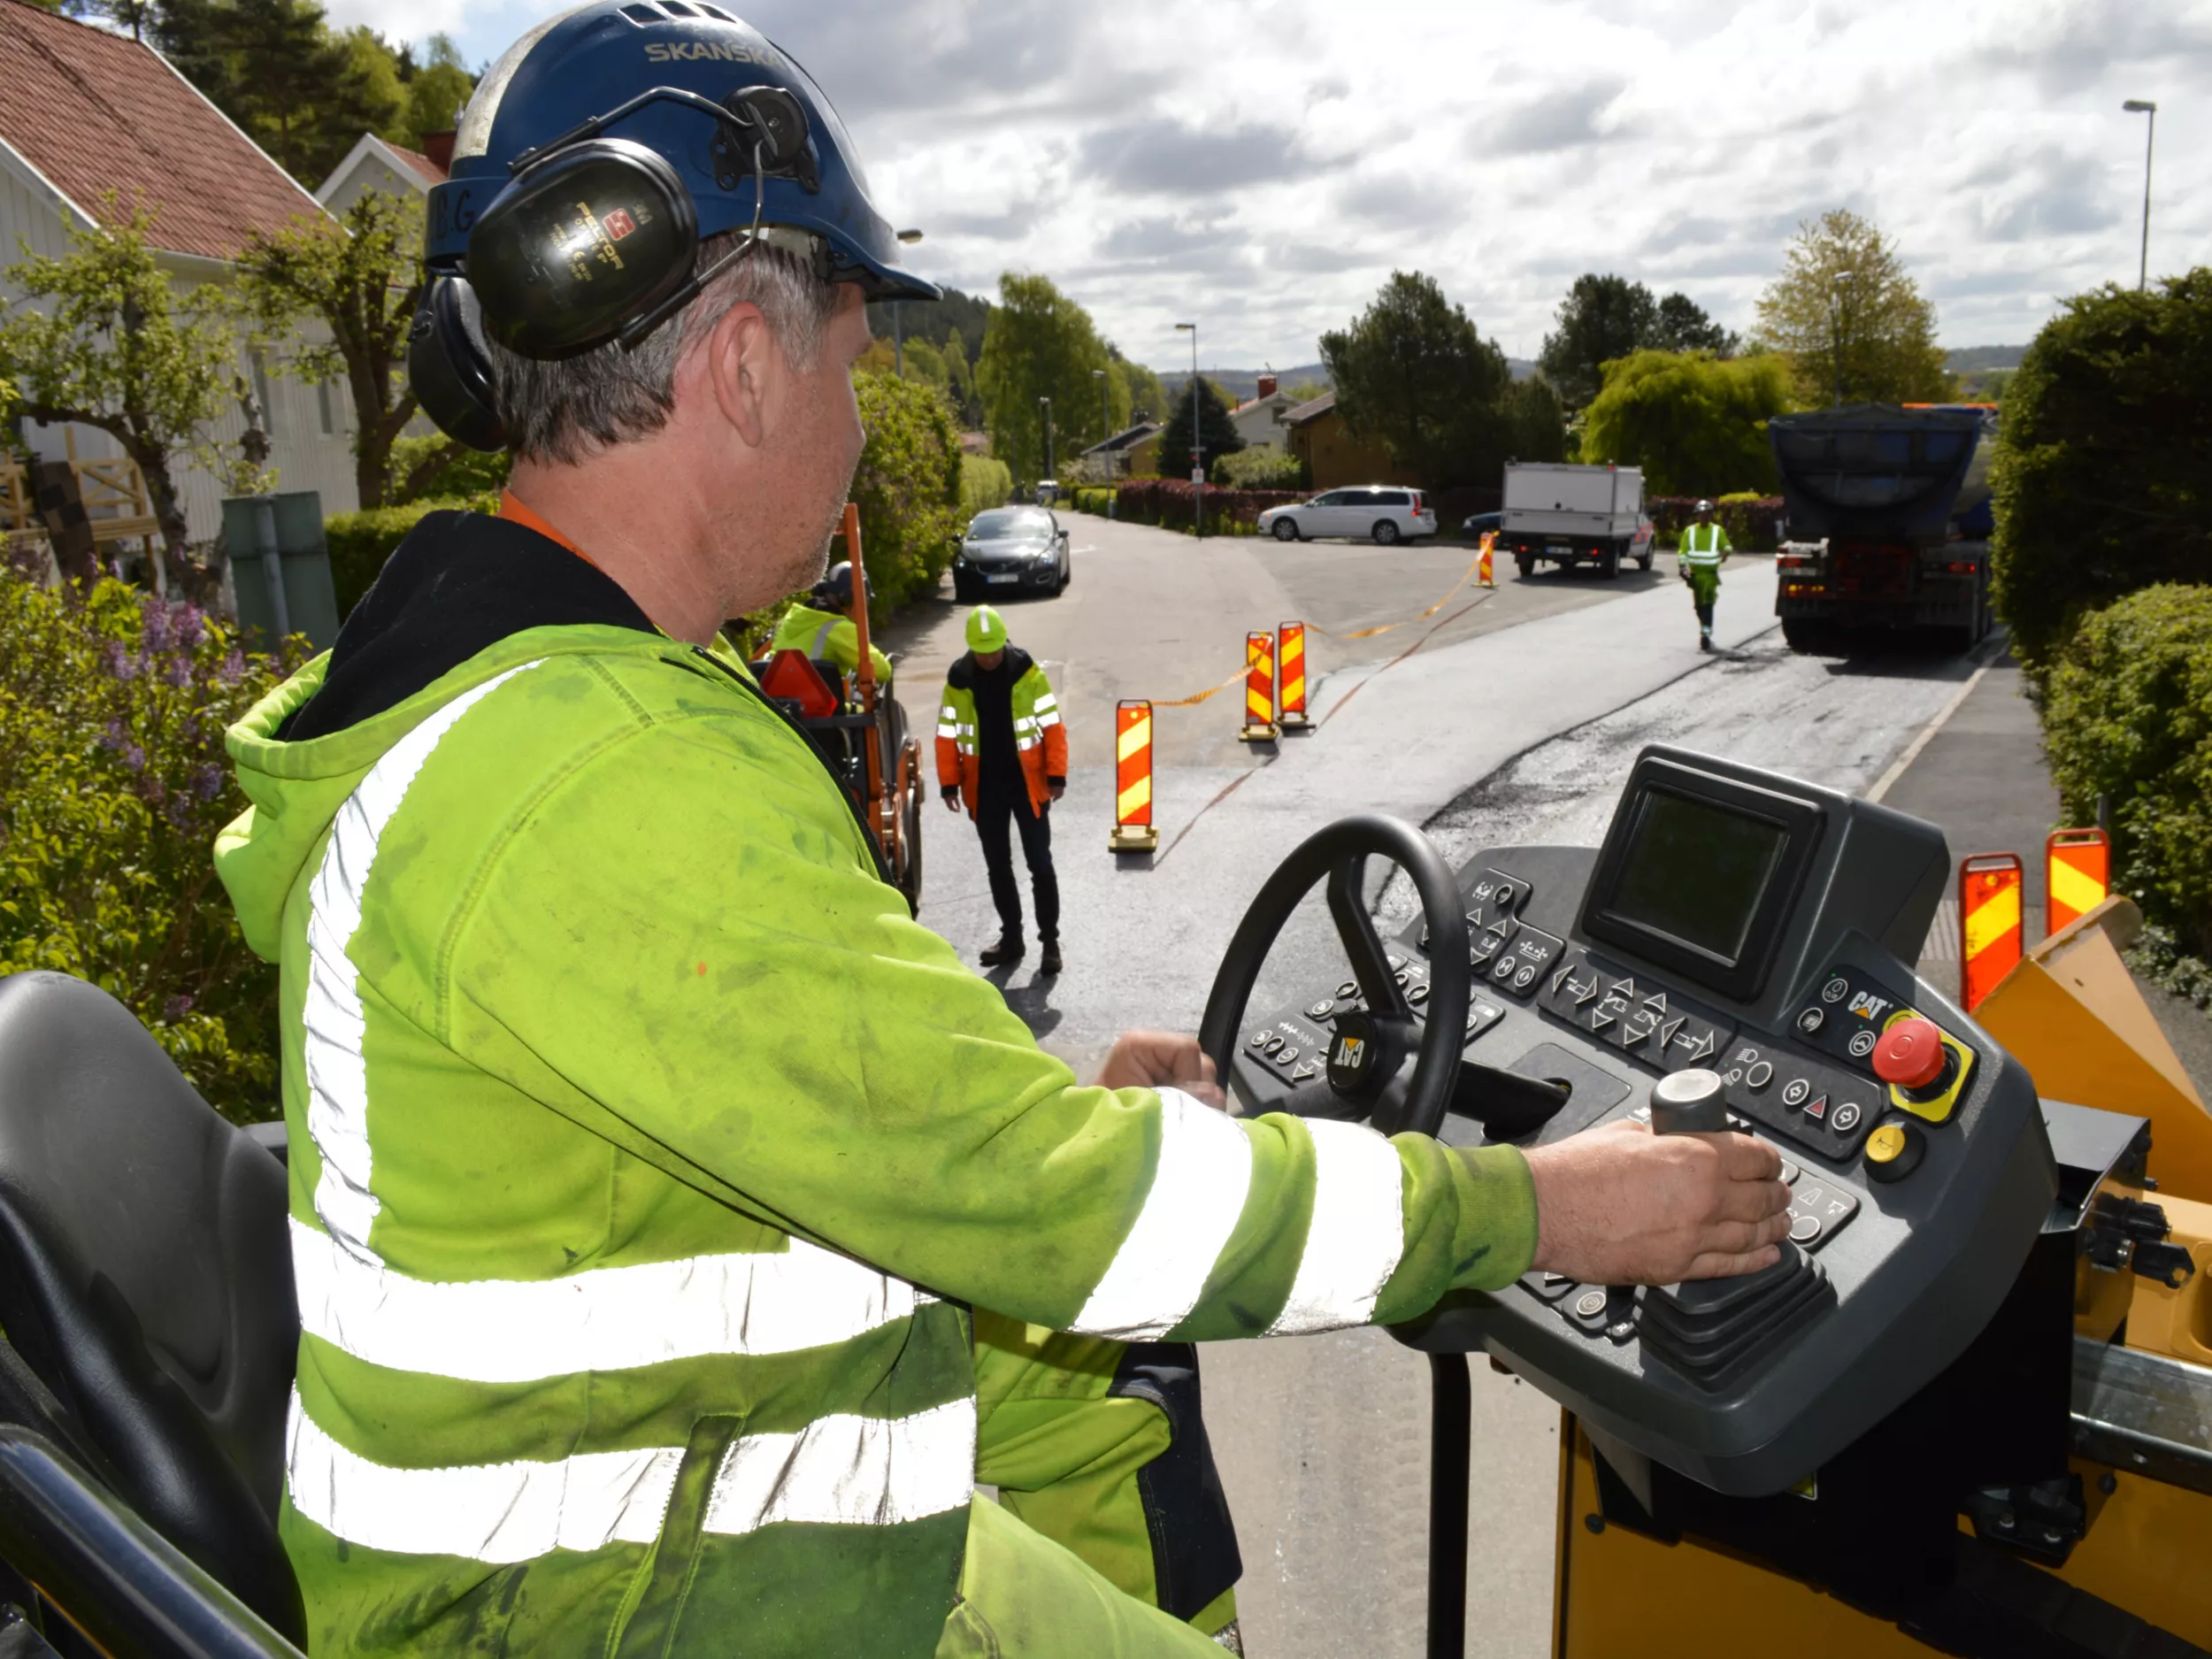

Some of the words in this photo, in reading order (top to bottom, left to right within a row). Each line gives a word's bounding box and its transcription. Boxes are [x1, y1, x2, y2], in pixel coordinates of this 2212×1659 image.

[643, 42, 785, 68] SKANSKA
[576, 201, 625, 271] PELTOR
[1847, 991, 1888, 1021] CAT
[1334, 1037, 1364, 1068] CAT
